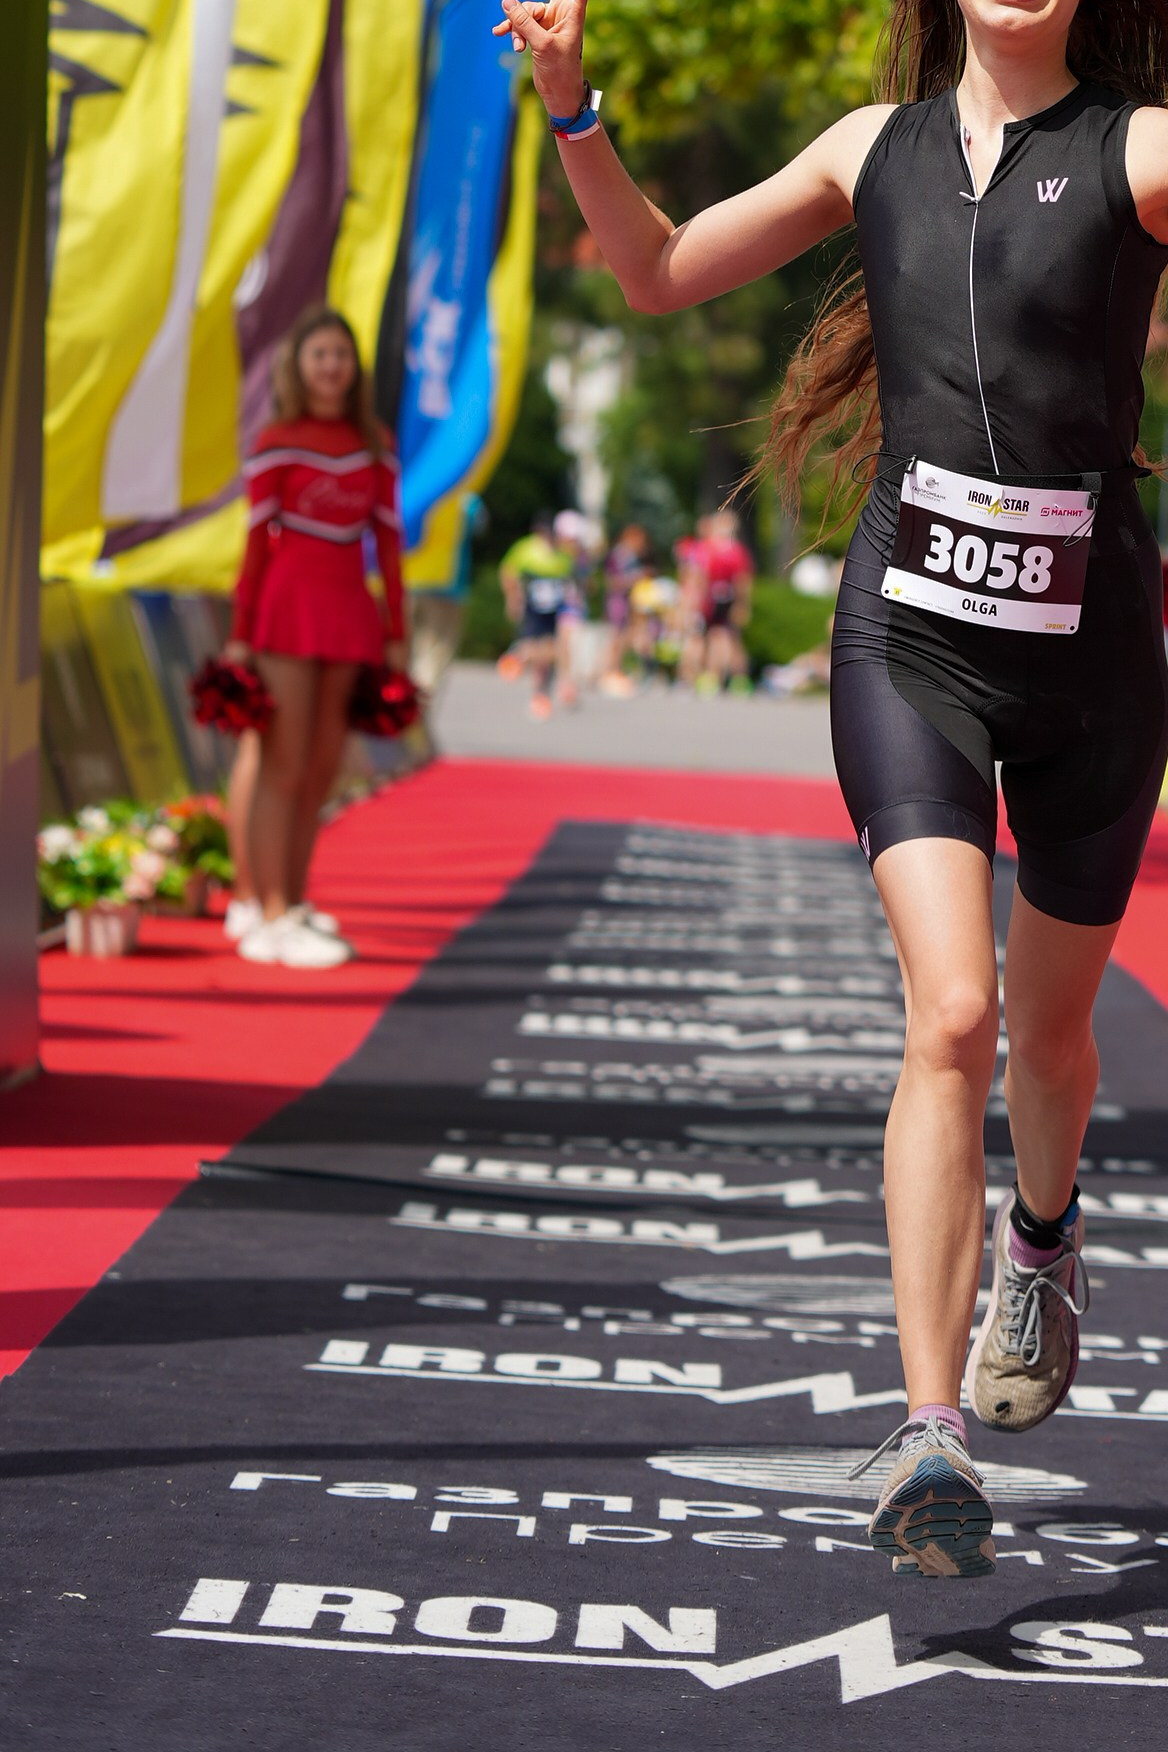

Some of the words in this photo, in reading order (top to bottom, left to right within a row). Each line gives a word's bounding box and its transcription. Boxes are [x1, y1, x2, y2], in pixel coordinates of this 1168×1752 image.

[967, 490, 992, 507] IRON
[1003, 498, 1030, 512] STAR
[1051, 509, 1083, 517] МАГНИТ
[923, 523, 1054, 594] 3058
[961, 598, 998, 617] OLGA
[1044, 622, 1067, 631] SPRINT
[319, 1340, 722, 1387] IRON
[178, 1578, 717, 1653] IRON
